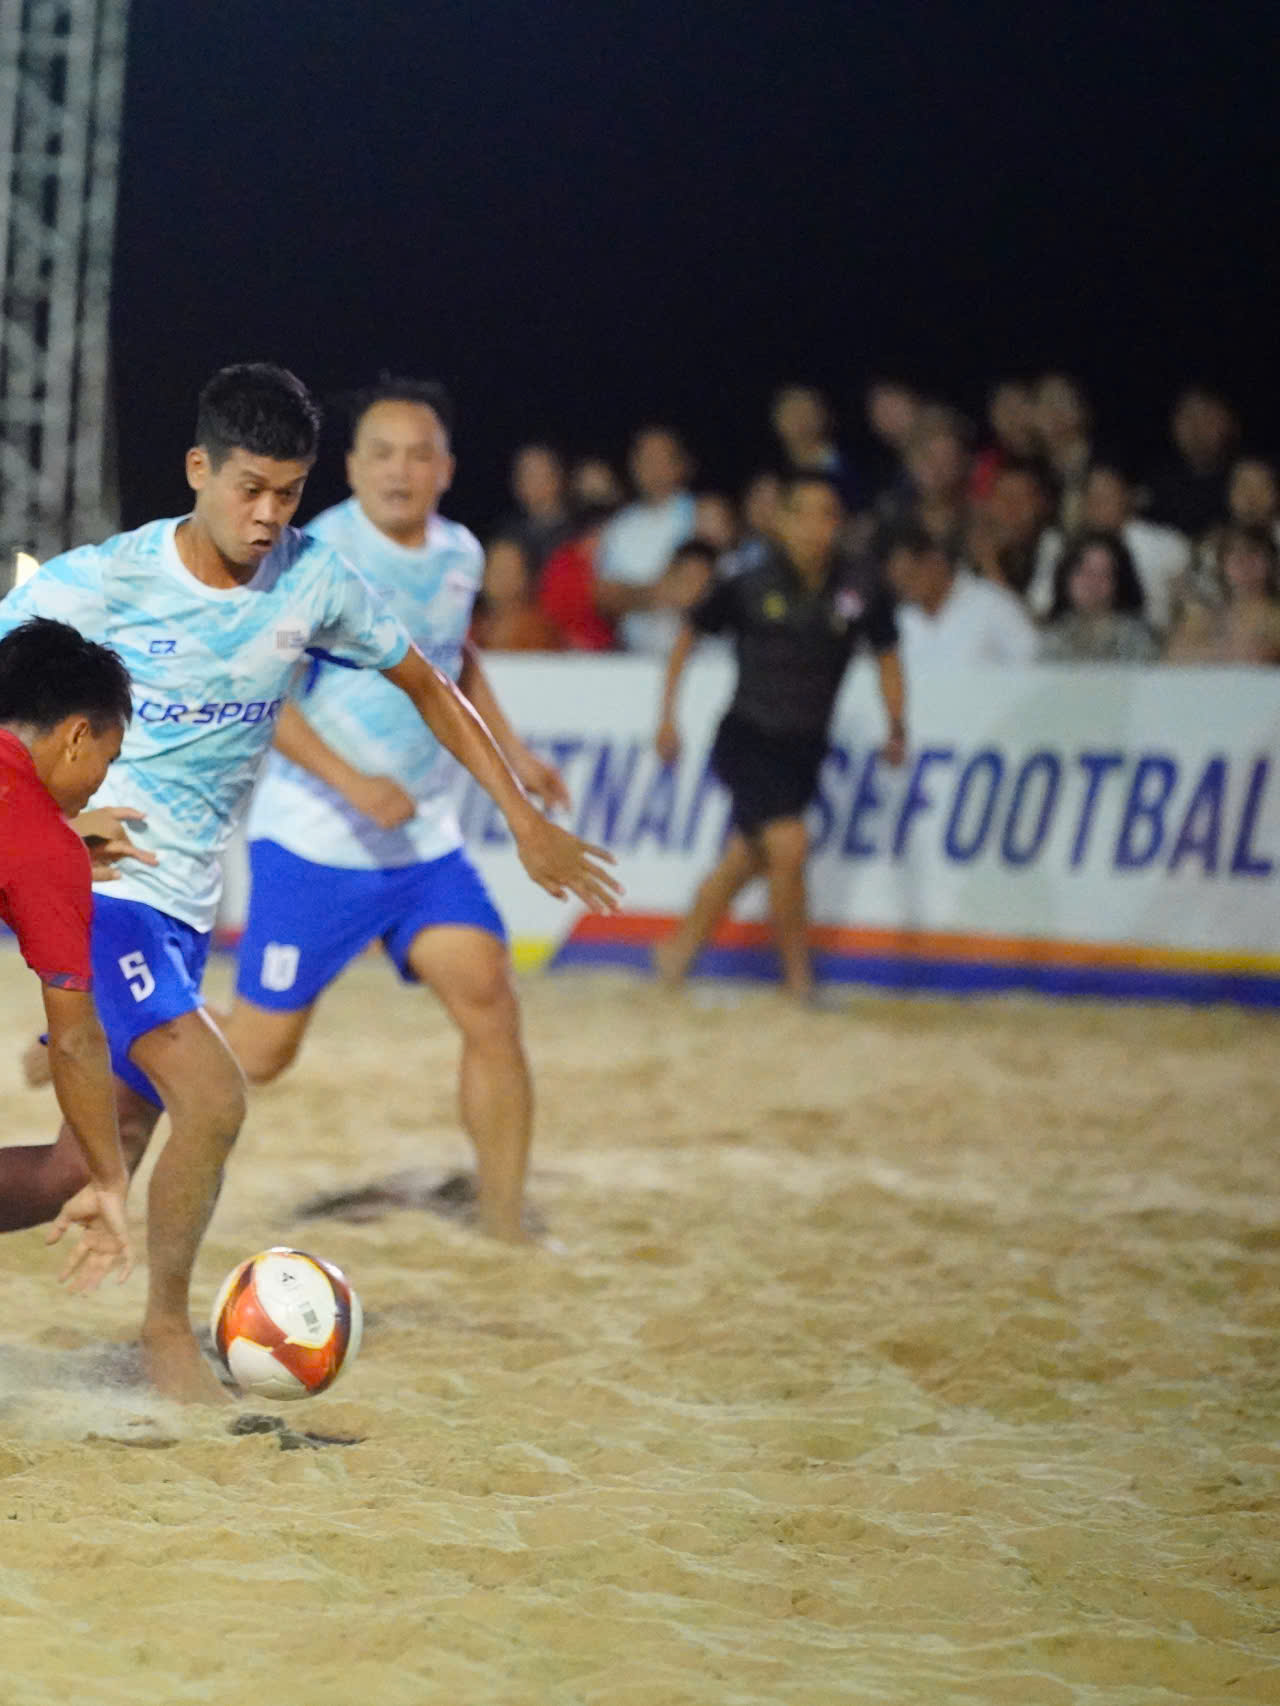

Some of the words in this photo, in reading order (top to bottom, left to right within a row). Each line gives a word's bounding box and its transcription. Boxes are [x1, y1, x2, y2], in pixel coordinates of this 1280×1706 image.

[138, 701, 188, 723] CR
[193, 698, 284, 724] SPOR
[890, 746, 1275, 878] FOOTBAL
[118, 951, 156, 1003] 5
